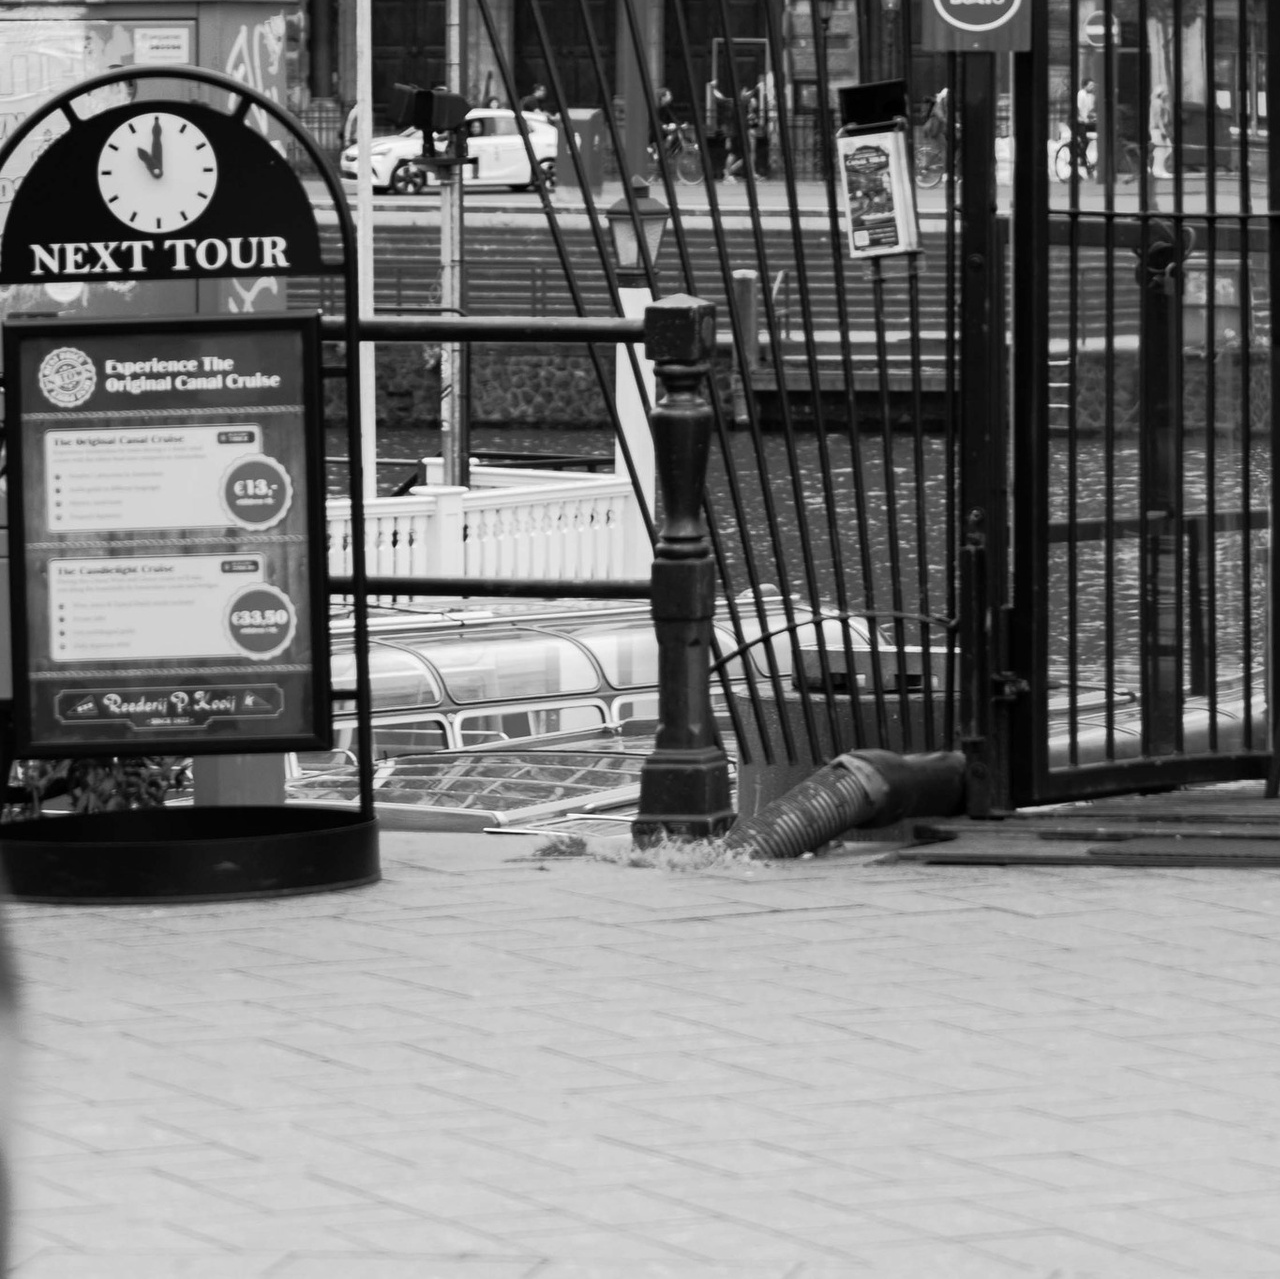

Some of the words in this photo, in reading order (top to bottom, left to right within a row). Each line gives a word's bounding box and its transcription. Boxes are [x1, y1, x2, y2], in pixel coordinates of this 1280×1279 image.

[30, 240, 154, 276] NEXT
[164, 236, 290, 271] TOUR
[105, 359, 199, 375] Experience
[201, 356, 234, 372] The
[105, 377, 172, 393] Original
[174, 375, 223, 391] Canal
[225, 372, 281, 389] Cruise
